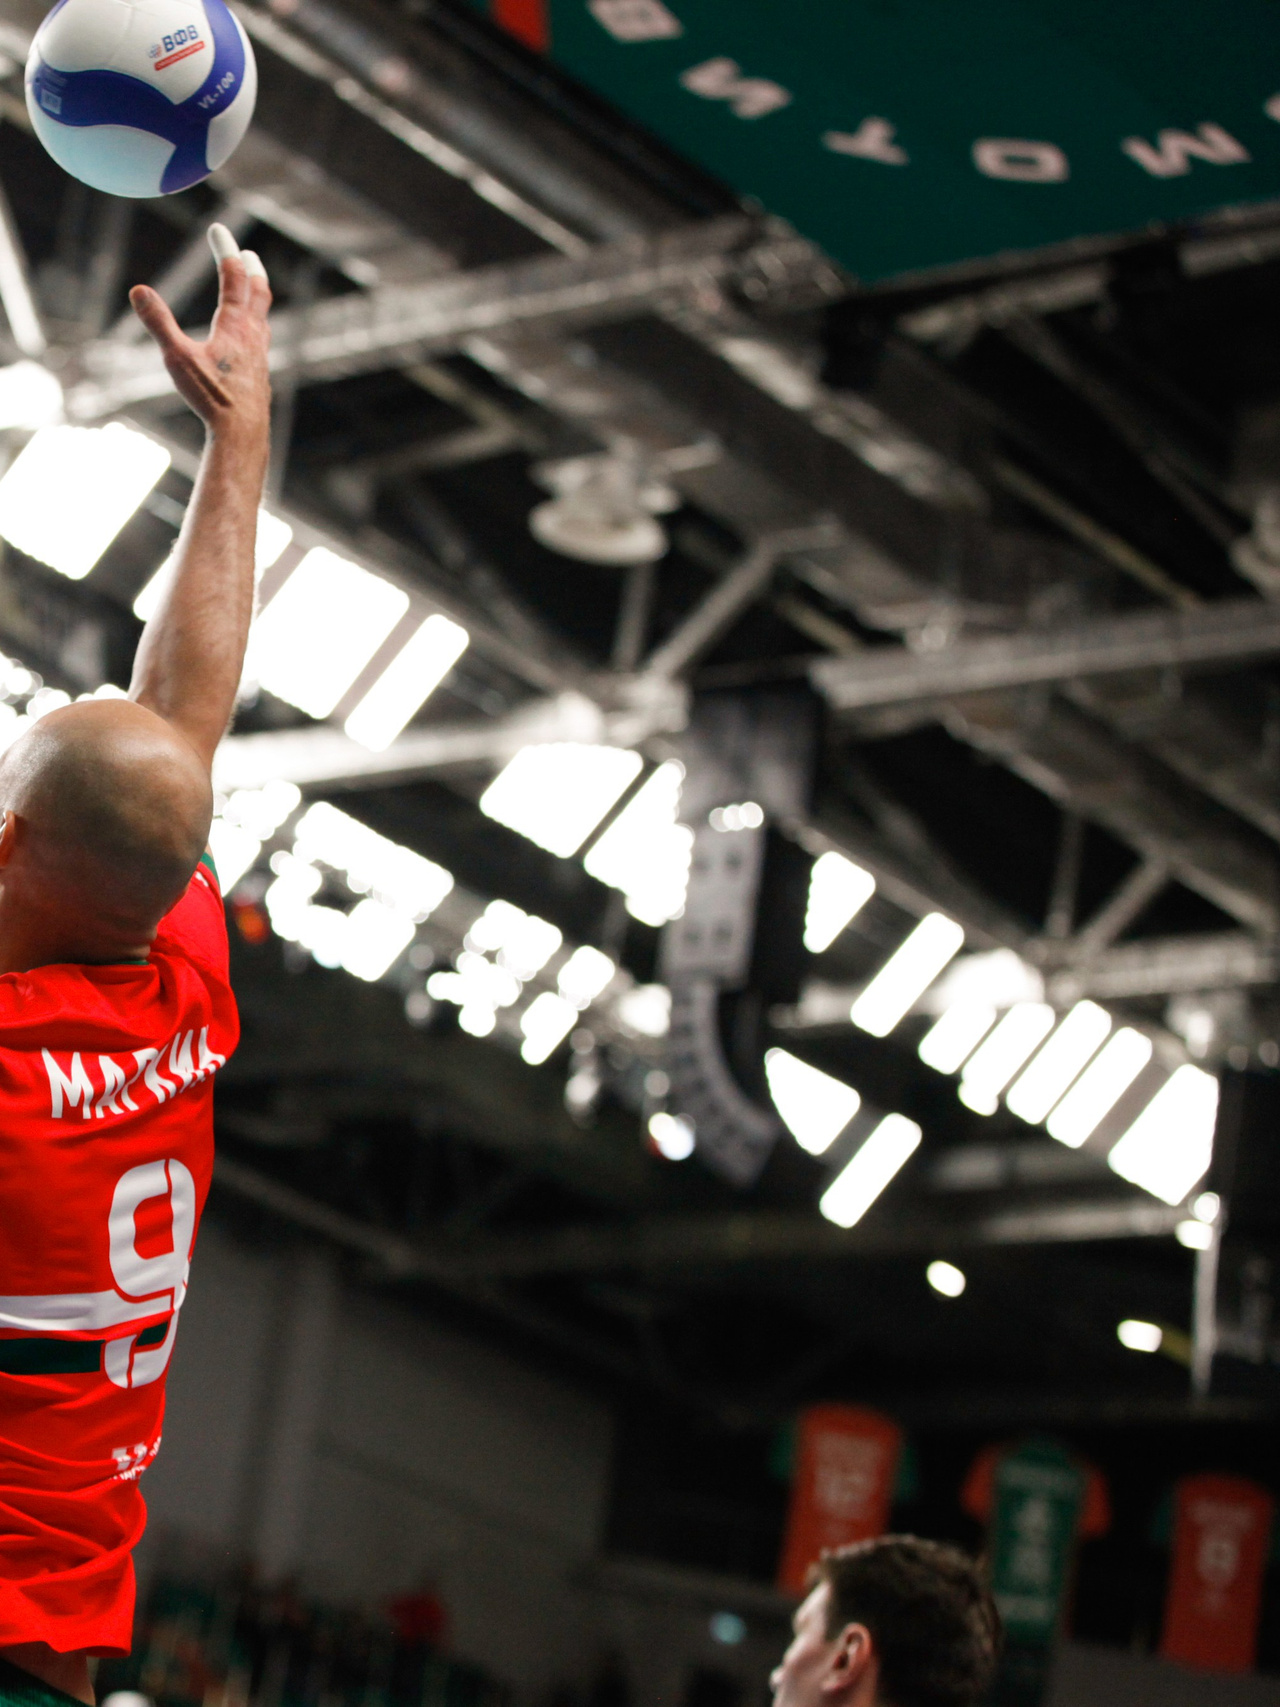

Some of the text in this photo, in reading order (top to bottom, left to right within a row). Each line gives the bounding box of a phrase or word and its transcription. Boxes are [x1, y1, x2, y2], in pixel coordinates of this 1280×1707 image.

[162, 24, 199, 53] ВФВ
[587, 0, 1280, 183] МОТИВ
[104, 1158, 195, 1389] 9
